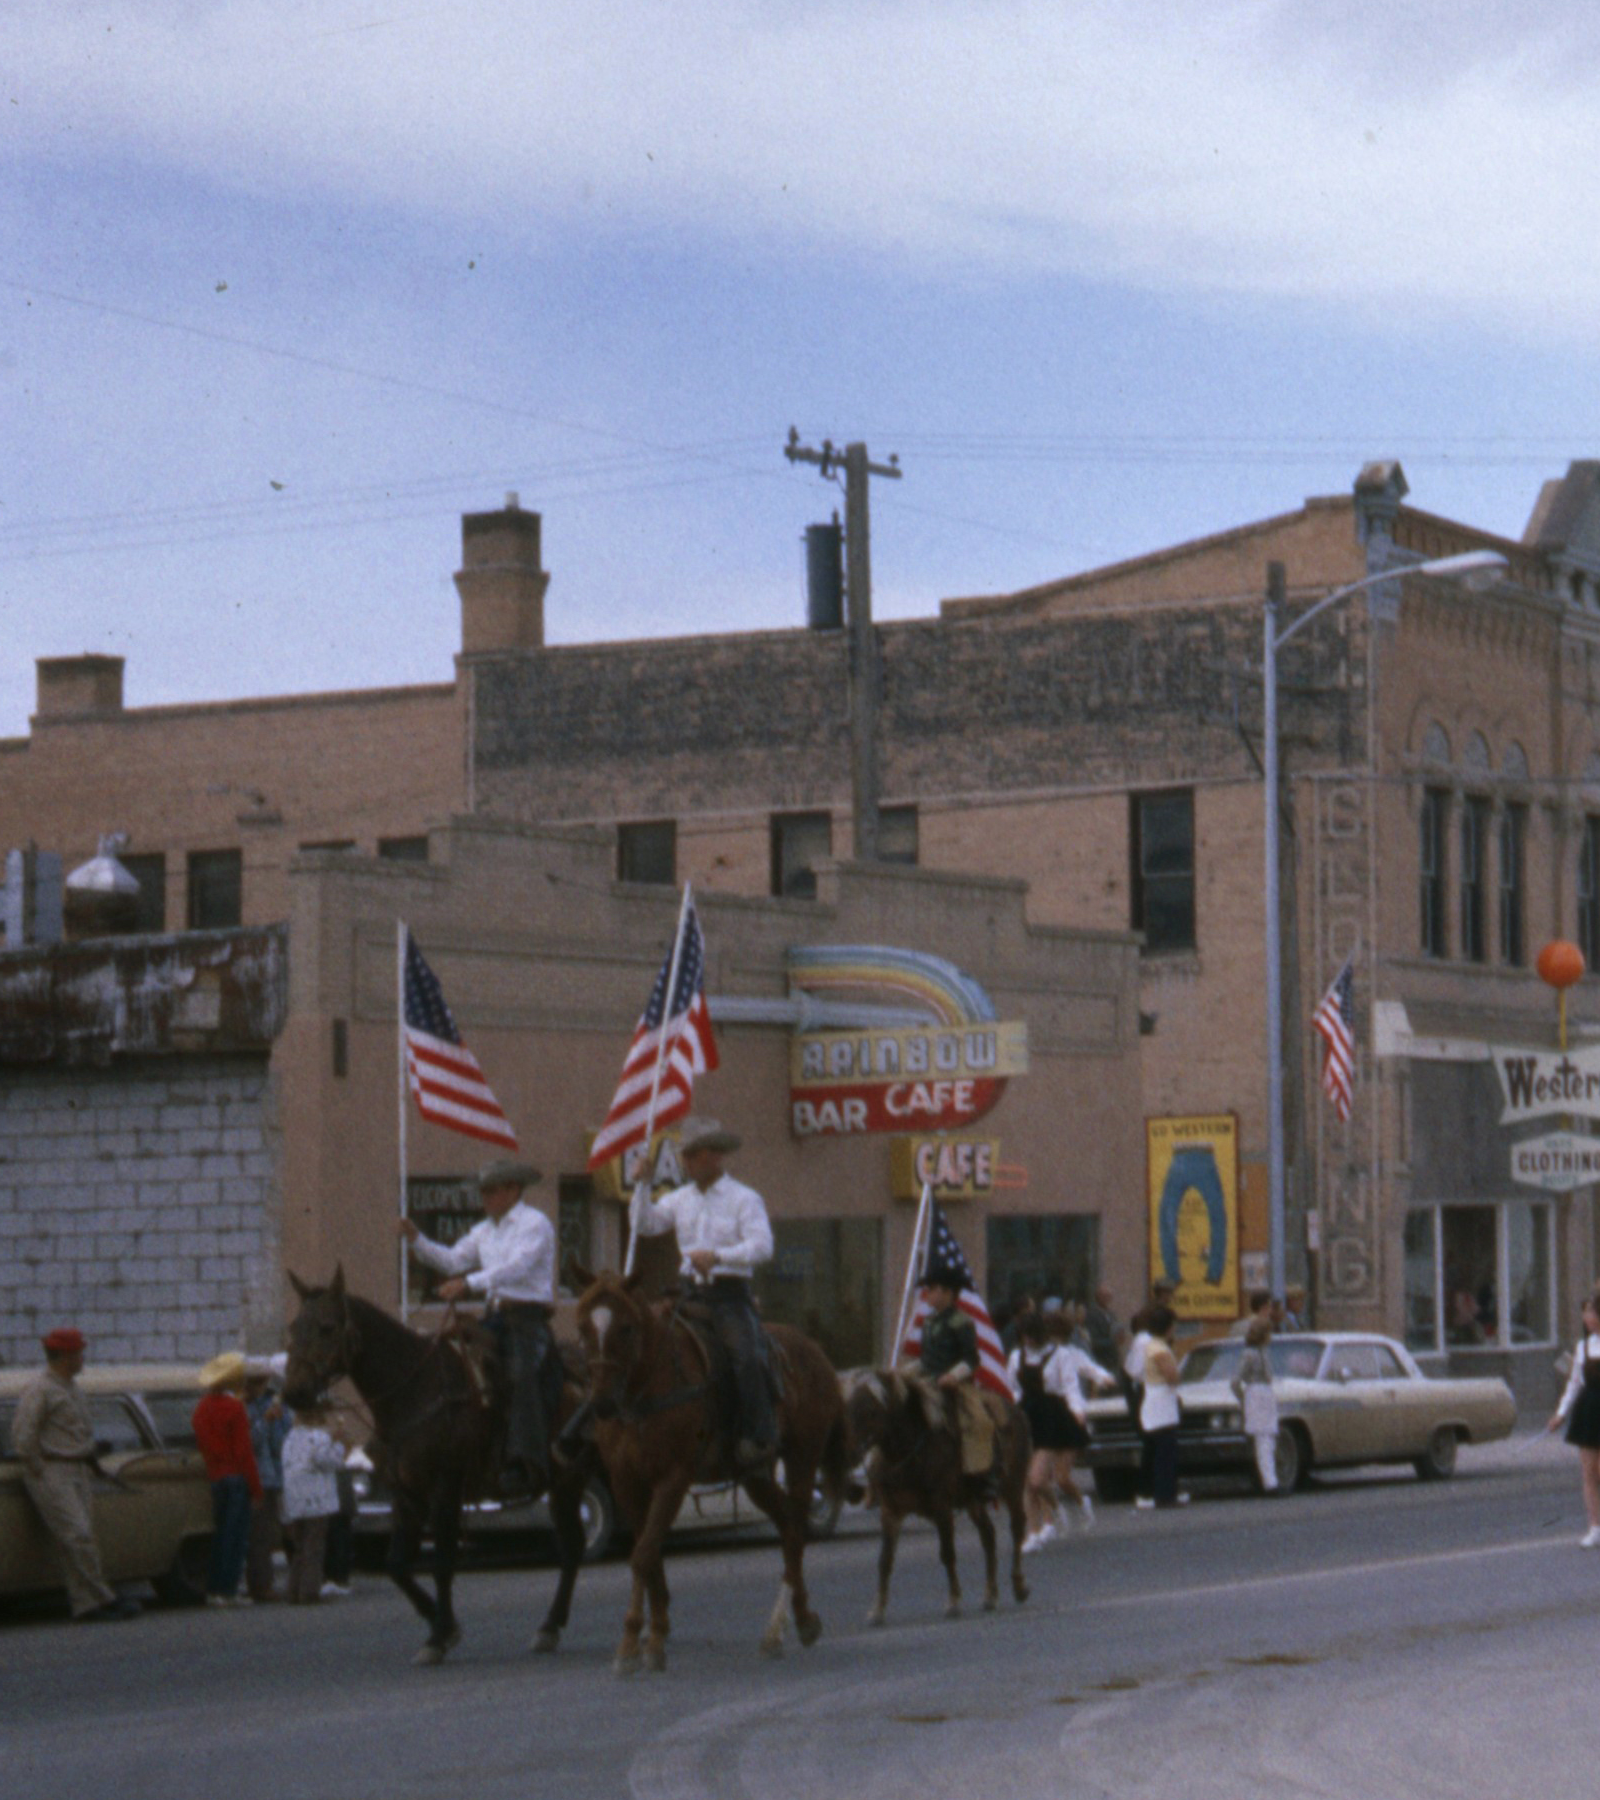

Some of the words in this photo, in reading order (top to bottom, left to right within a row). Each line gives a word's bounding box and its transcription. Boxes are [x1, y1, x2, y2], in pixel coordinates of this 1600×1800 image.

[802, 1030, 997, 1079] RAINBOW
[792, 1098, 868, 1135] BAR
[884, 1079, 977, 1118] CAFE
[1172, 1122, 1231, 1136] WESTERN
[915, 1142, 993, 1189] CAFE
